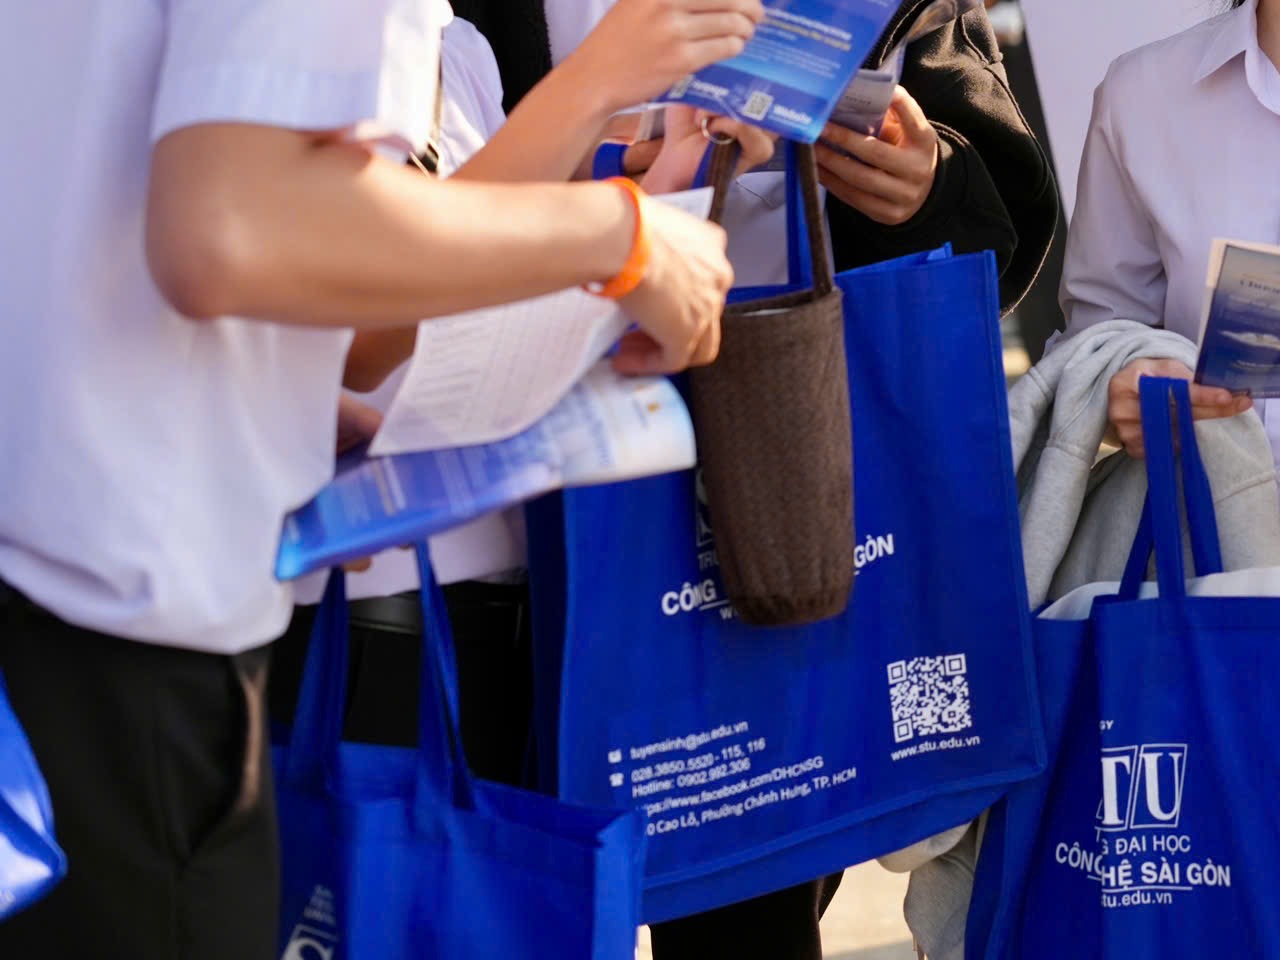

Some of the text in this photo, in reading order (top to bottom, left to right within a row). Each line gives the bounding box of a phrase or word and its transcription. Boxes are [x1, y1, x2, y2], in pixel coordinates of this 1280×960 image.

[853, 533, 895, 568] GÒN
[747, 737, 766, 754] 116
[890, 735, 981, 761] www.stu.edu.vn
[632, 778, 675, 798] Hotline:
[656, 818, 680, 833] Cao
[832, 766, 857, 785] HCM
[1100, 752, 1184, 826] TU
[1115, 836, 1146, 856] ĐẠI
[1152, 835, 1191, 856] HỌC
[1141, 856, 1180, 884] SÀI
[1186, 857, 1231, 888] GÒN
[1101, 890, 1172, 908] tu.edu.vn
